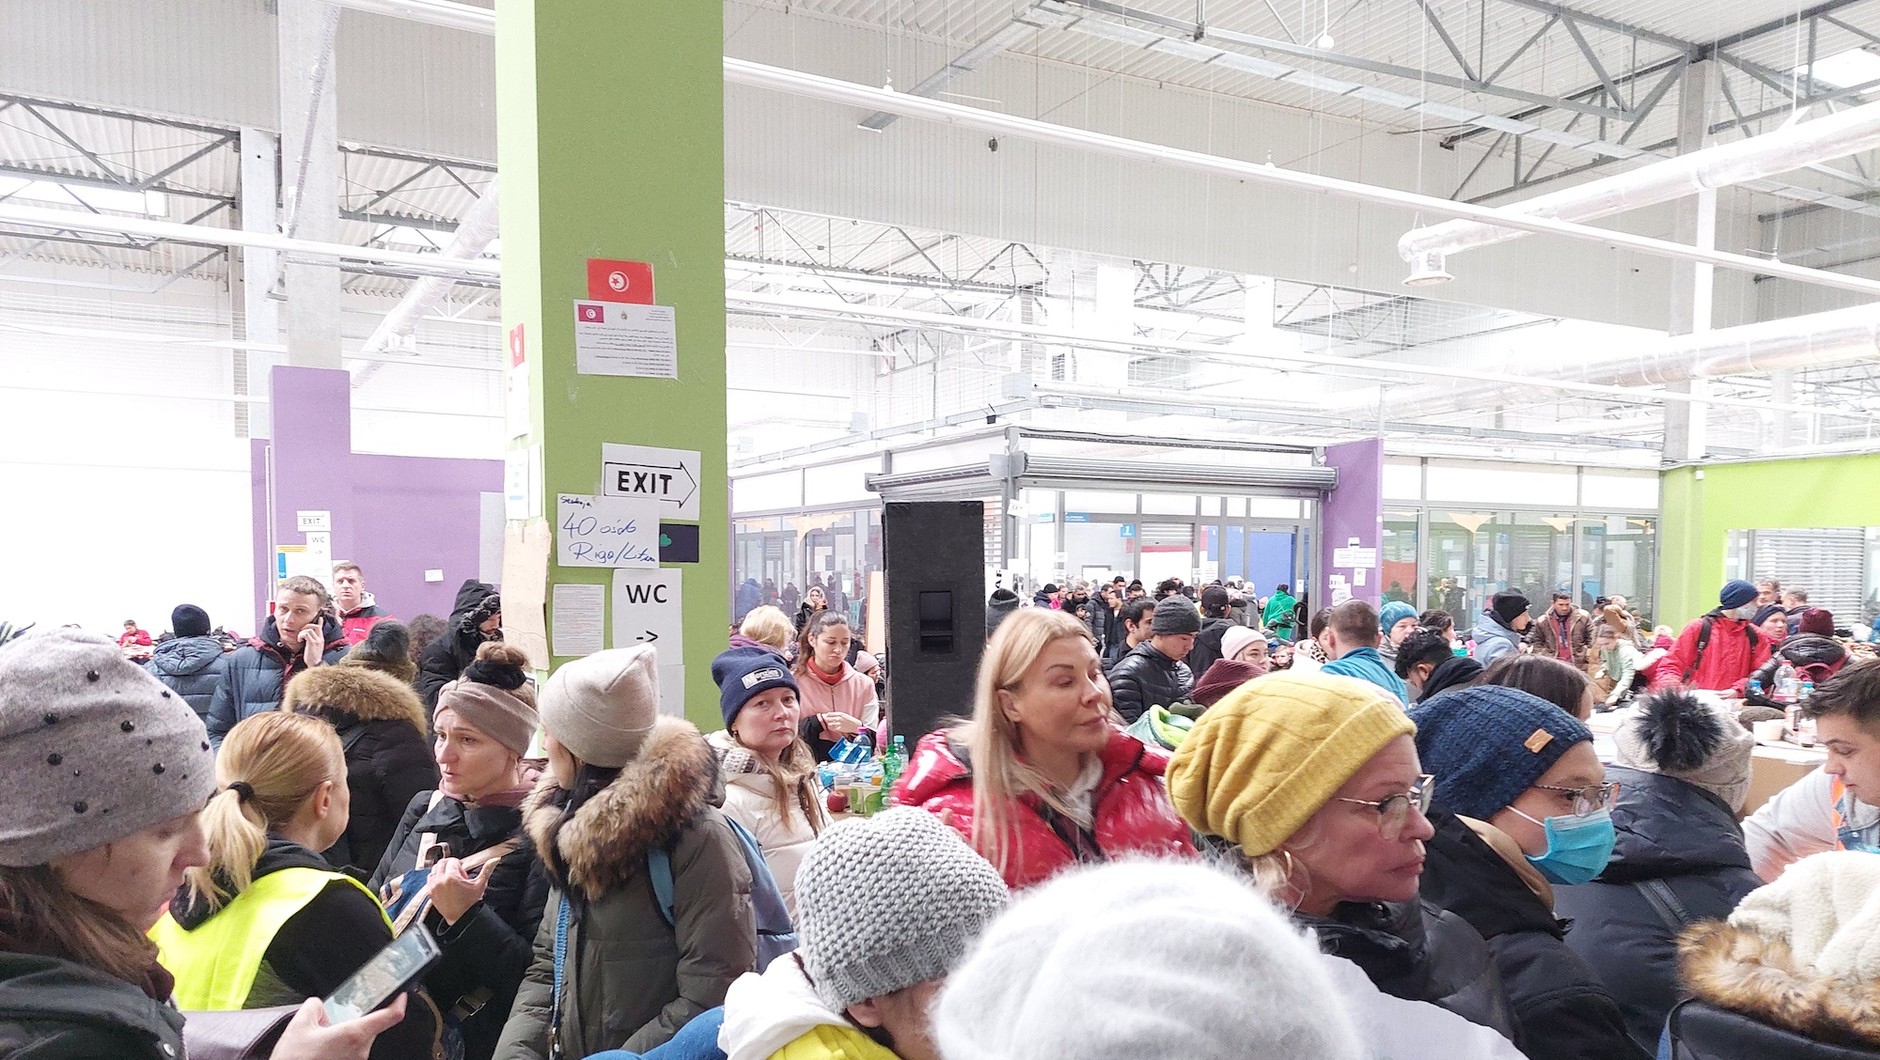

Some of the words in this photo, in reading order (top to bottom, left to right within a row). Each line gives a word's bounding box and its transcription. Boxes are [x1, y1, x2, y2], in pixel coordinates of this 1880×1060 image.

[617, 470, 672, 494] EXIT
[563, 512, 597, 538] 40
[626, 584, 667, 604] WC
